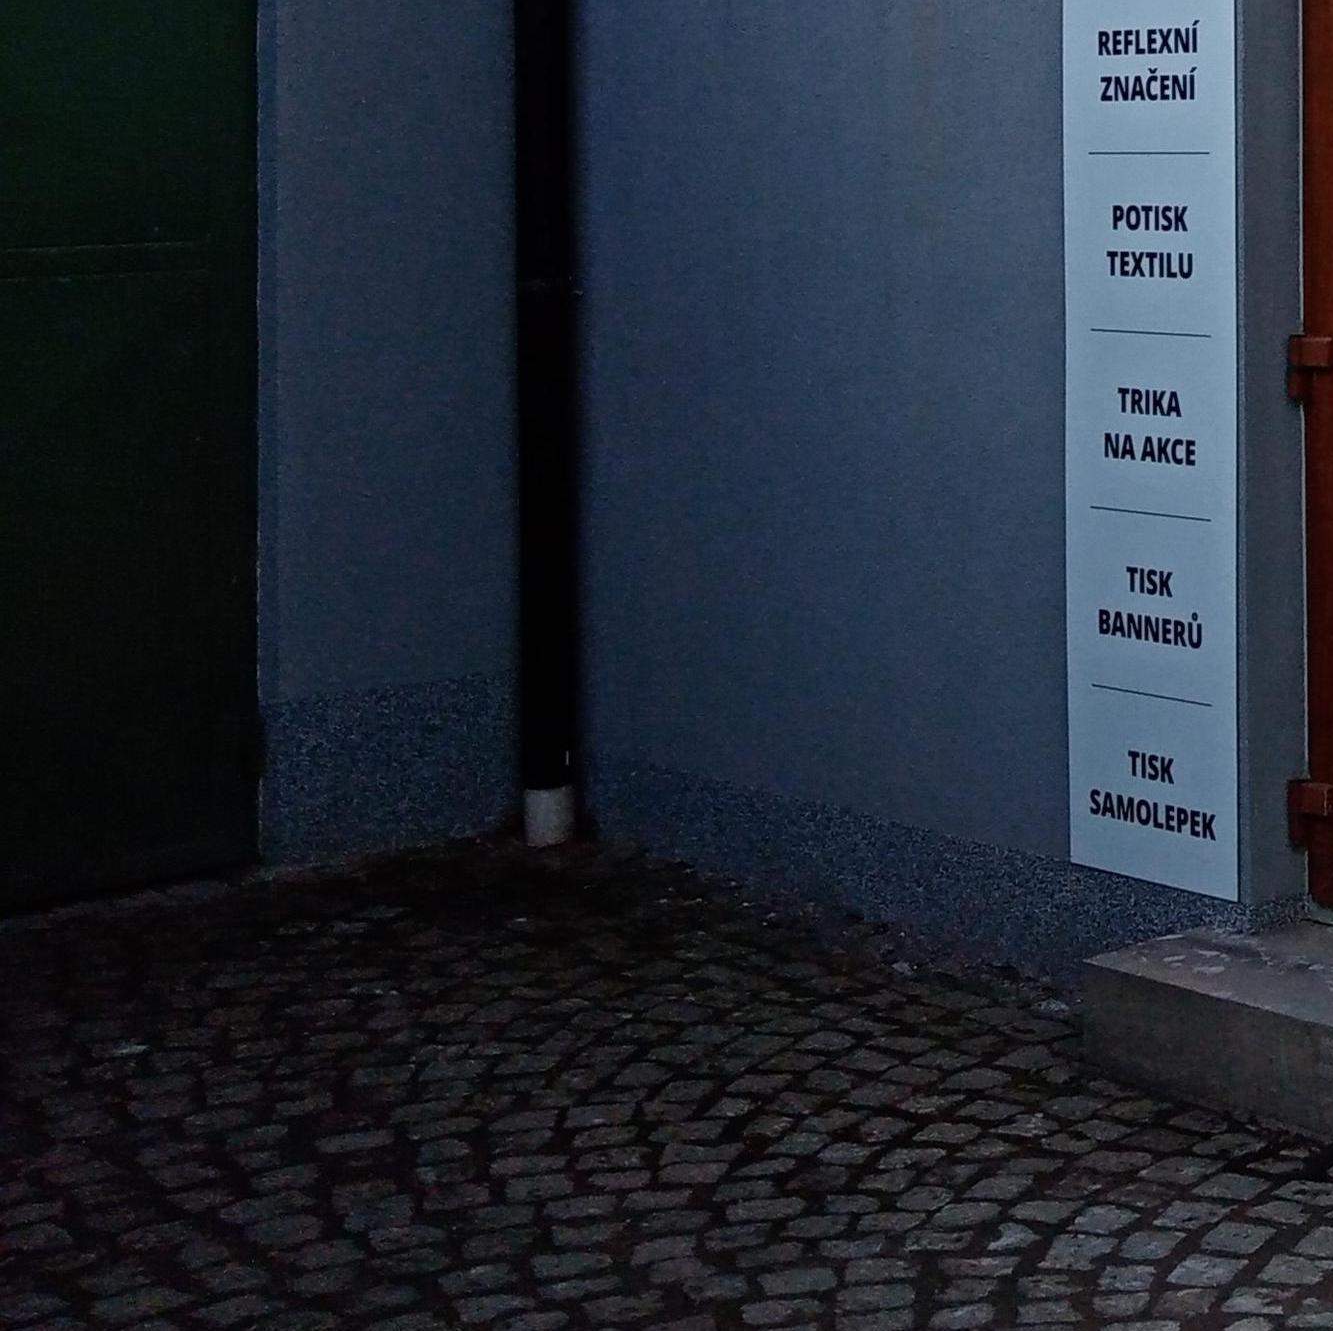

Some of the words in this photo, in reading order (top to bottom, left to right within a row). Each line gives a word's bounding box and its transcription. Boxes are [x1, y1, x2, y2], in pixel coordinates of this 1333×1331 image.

[1098, 20, 1200, 56] REFLEXNÍ
[1100, 67, 1197, 102] ZNAČENÍ
[1112, 204, 1188, 232] POTISK
[1106, 250, 1193, 279] TEXTILU
[1118, 387, 1182, 418] TRIKA
[1104, 432, 1136, 461] NA
[1140, 436, 1196, 466] AKCE
[1126, 566, 1173, 598] TISK
[1098, 608, 1202, 649] BANNERŮ
[1128, 750, 1174, 785] TISK
[1090, 789, 1216, 841] SAMOLEPEK
